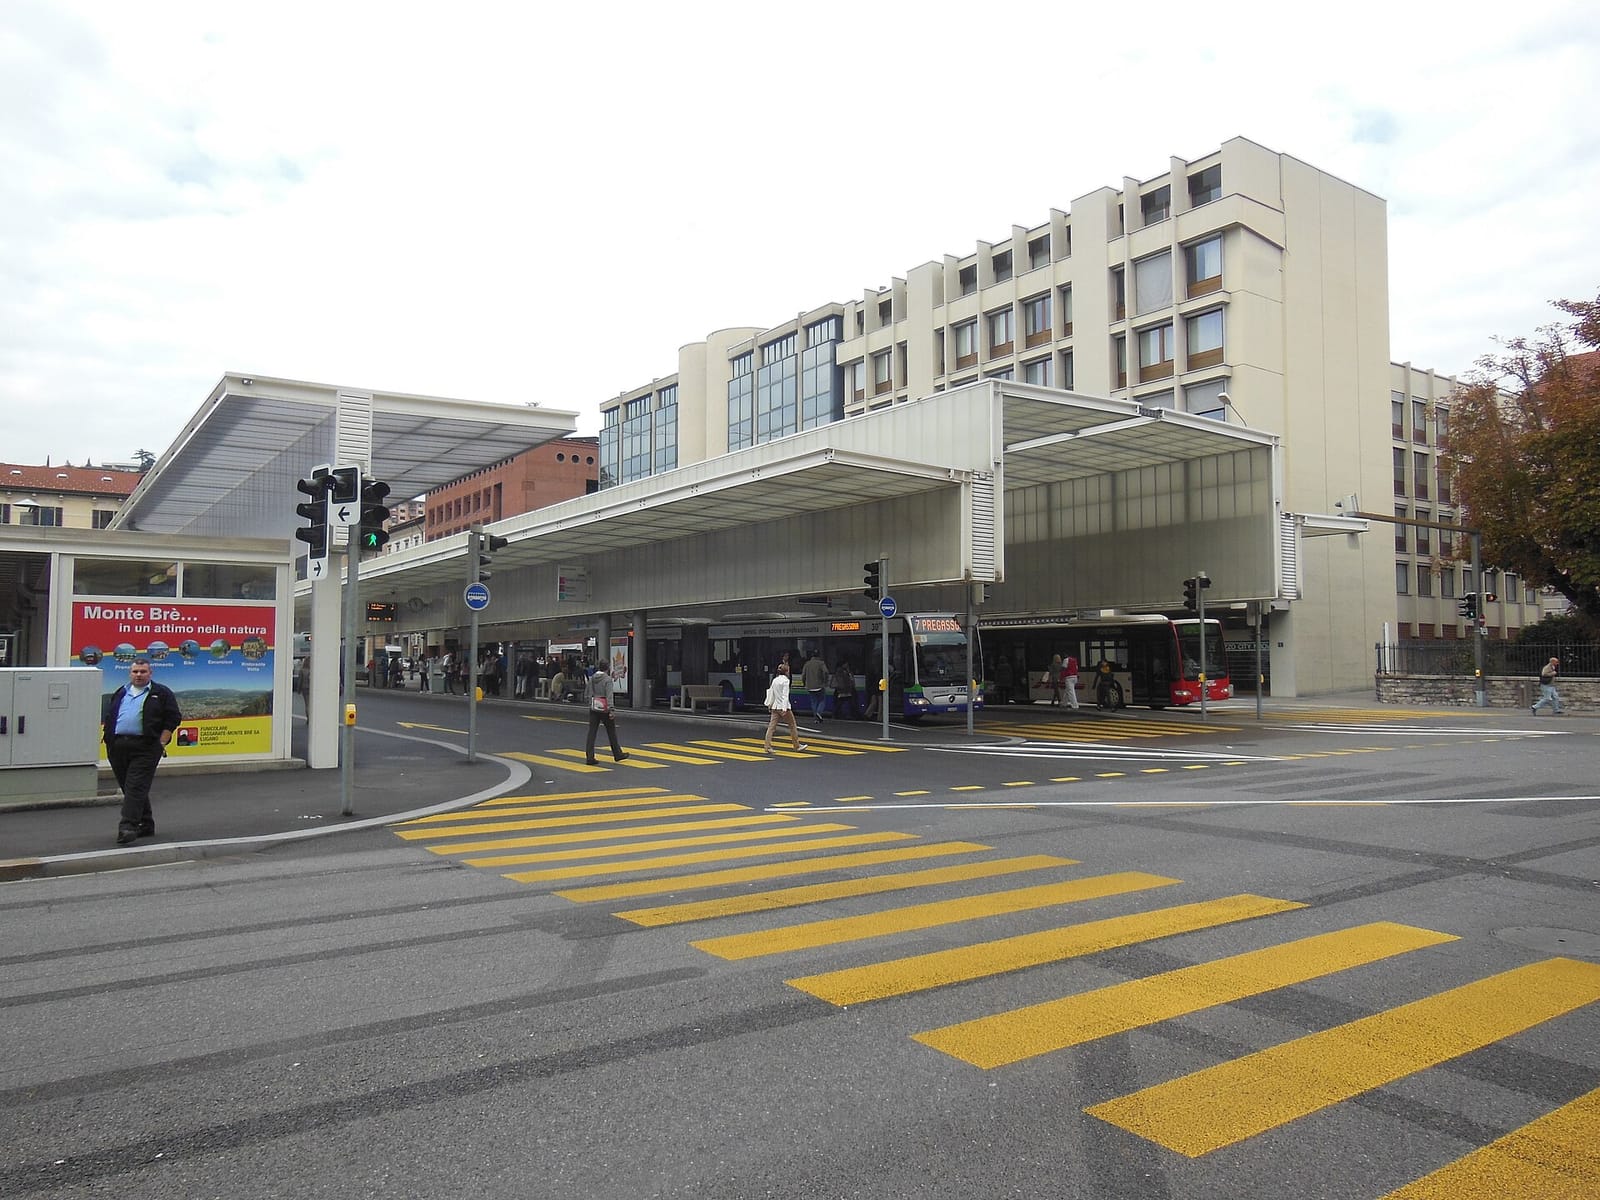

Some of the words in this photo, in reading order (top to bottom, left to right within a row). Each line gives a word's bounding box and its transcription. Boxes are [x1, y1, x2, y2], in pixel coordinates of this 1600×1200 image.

[84, 605, 144, 620] Monte
[149, 607, 198, 621] Brè...
[119, 623, 131, 633] in
[135, 625, 150, 634] un
[154, 624, 194, 634] attimo
[197, 624, 226, 634] nella
[229, 625, 267, 635] natura
[915, 620, 920, 631] 7
